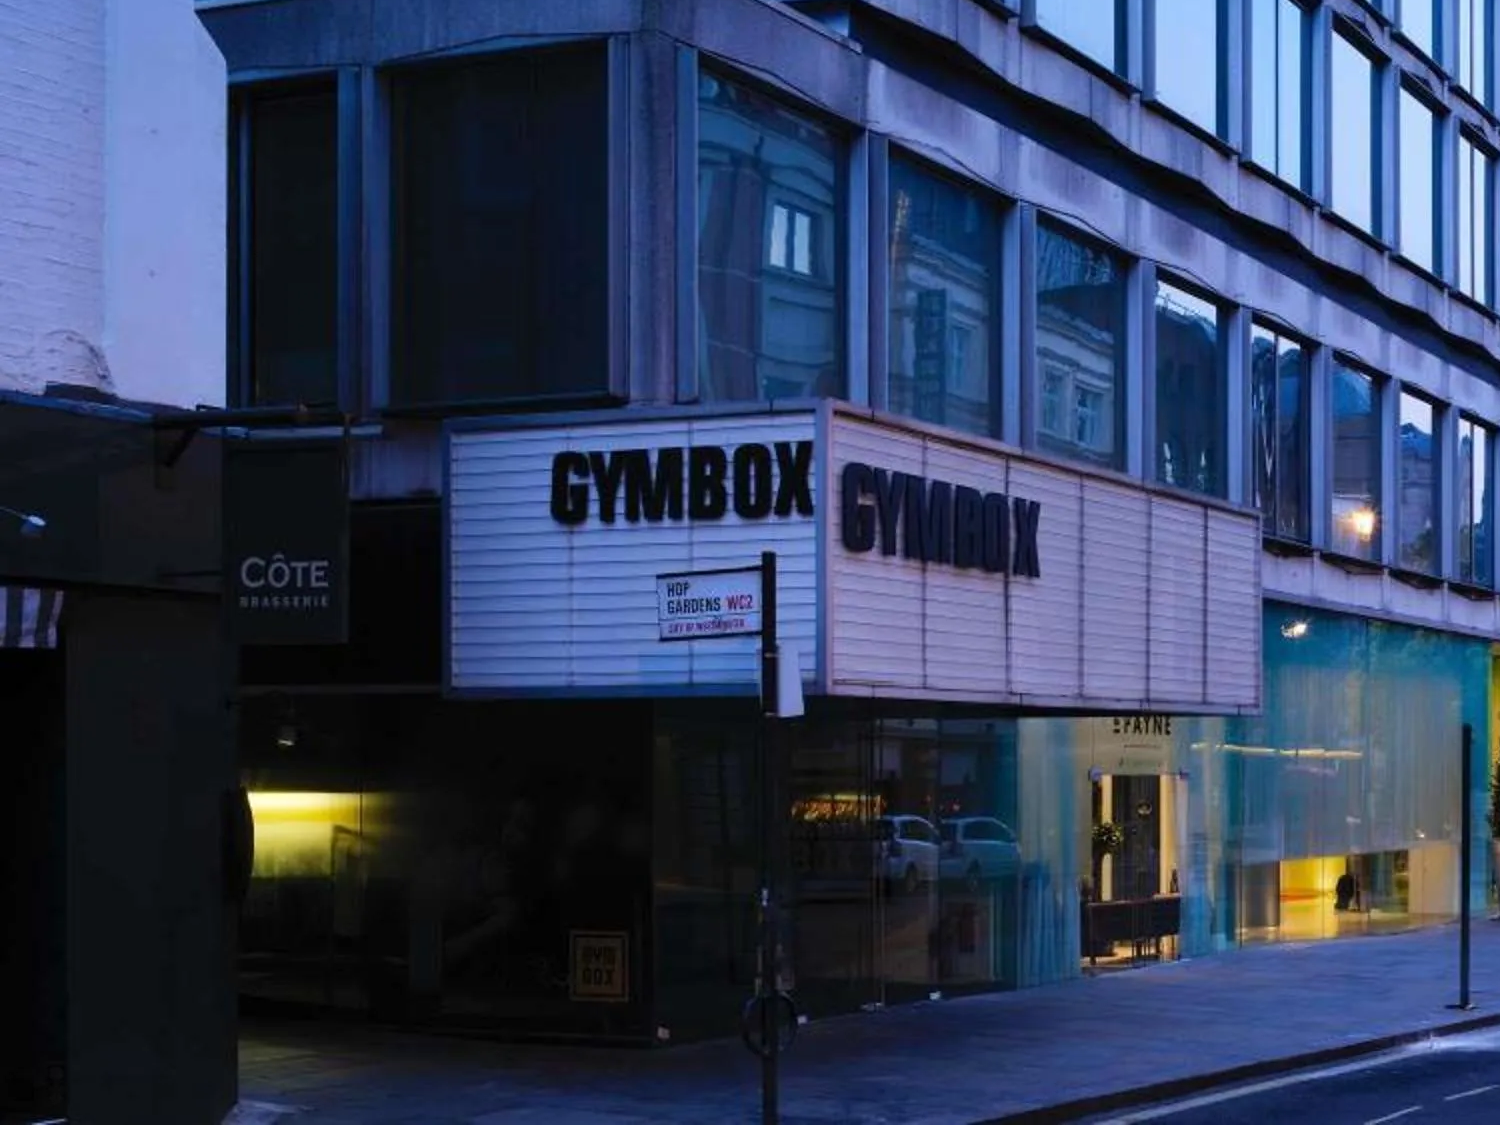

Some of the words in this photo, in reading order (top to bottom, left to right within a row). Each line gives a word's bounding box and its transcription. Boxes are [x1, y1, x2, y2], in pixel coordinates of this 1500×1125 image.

[550, 441, 814, 524] GYMBOX
[841, 462, 1042, 578] GYMBOX
[240, 552, 329, 588] CÔTE
[239, 595, 329, 609] BRASSERIE
[667, 582, 689, 597] HOP
[667, 597, 721, 614] GARDENS
[726, 594, 753, 610] WC2
